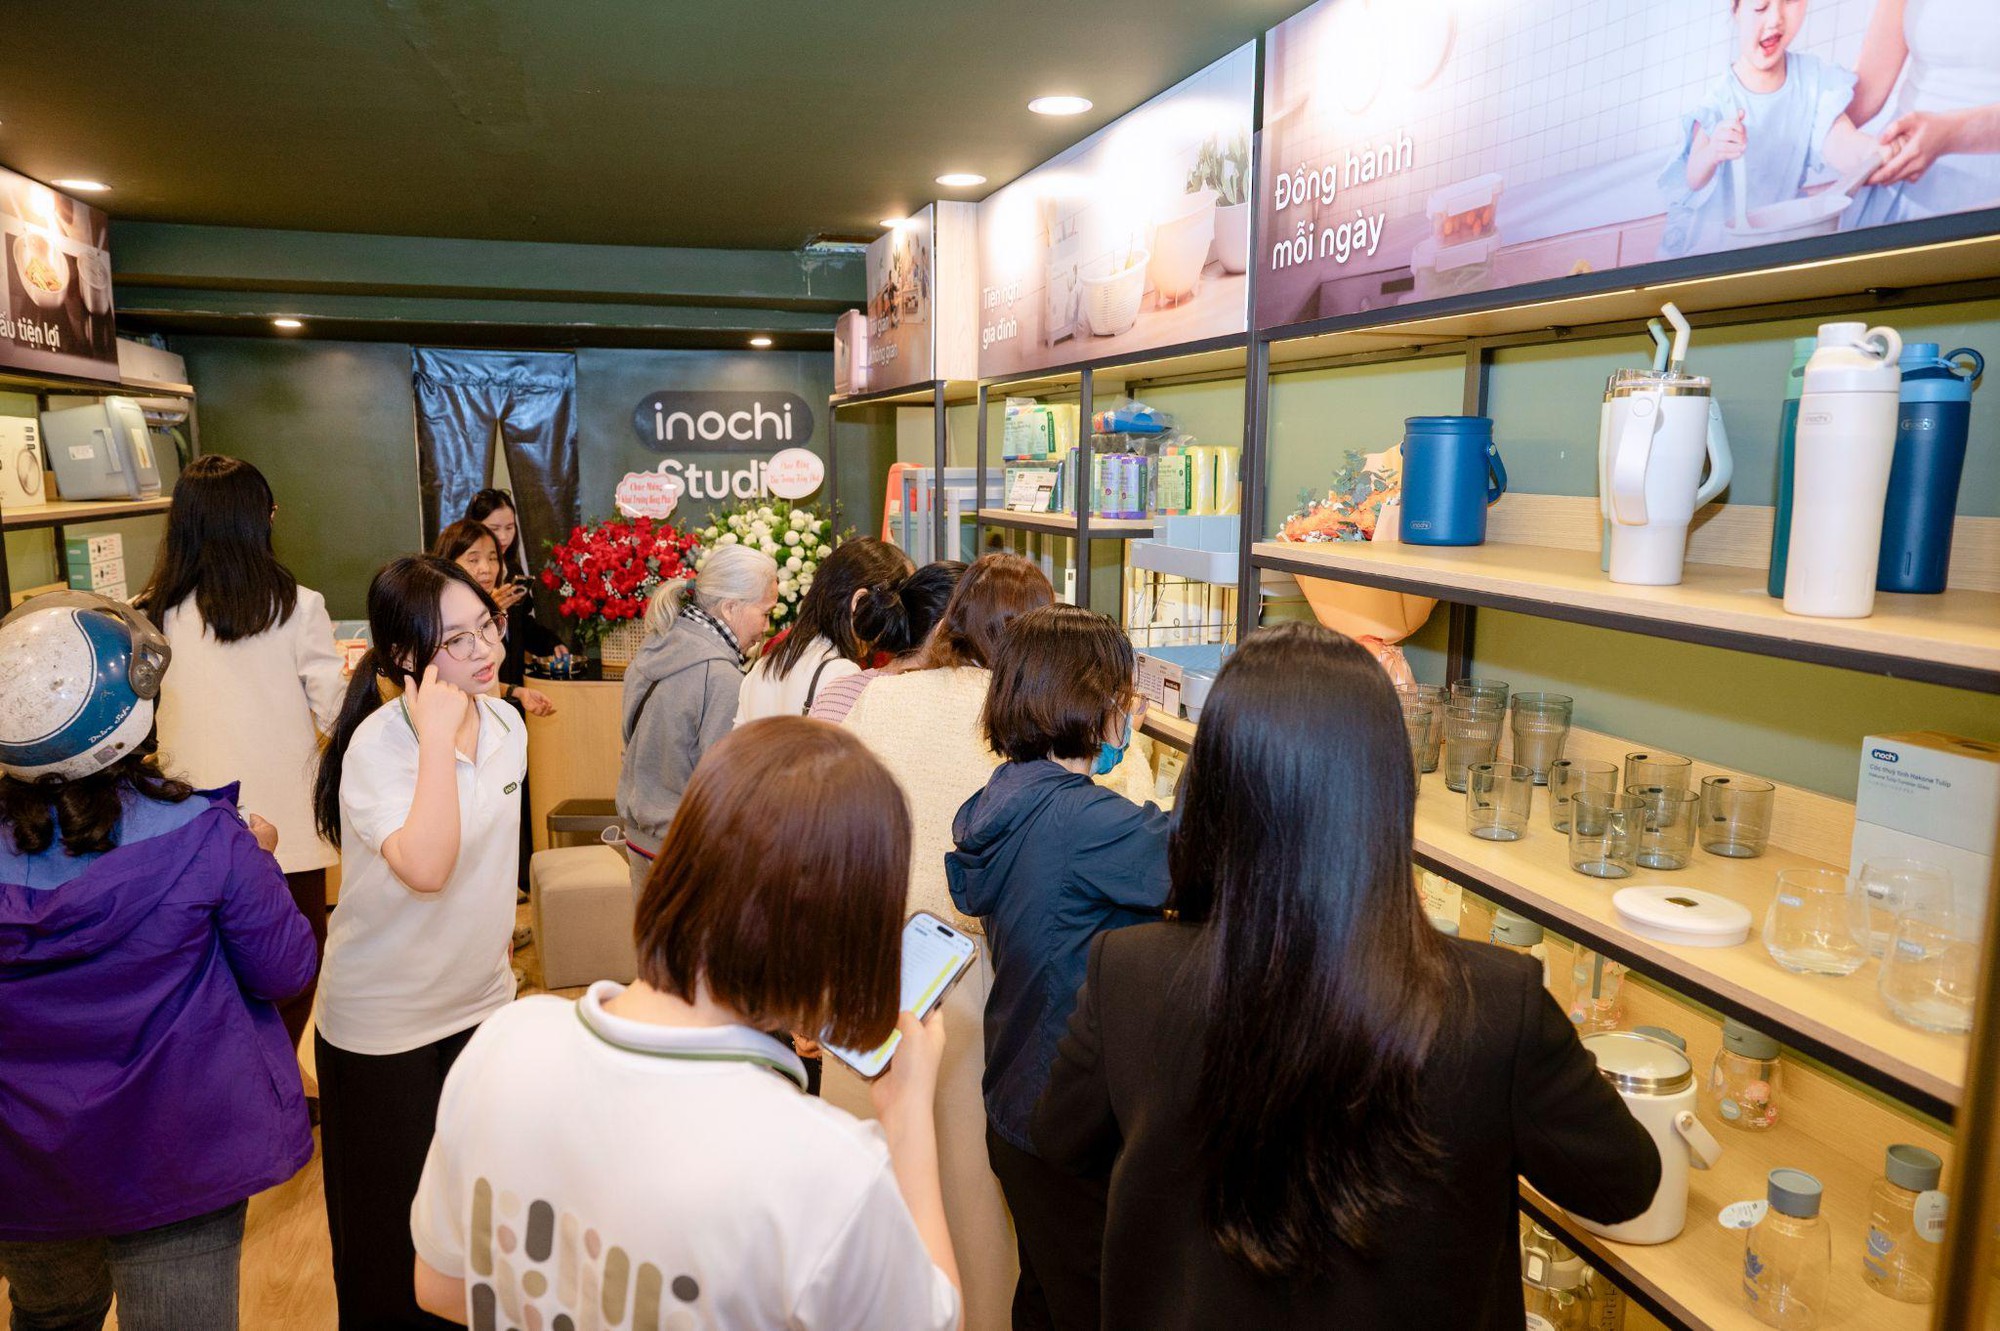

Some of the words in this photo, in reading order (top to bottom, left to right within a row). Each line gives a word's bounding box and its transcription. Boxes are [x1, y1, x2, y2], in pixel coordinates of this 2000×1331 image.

[1275, 162, 1337, 211] Đồng
[1344, 130, 1413, 188] hành
[1272, 220, 1315, 270] mỗi
[1320, 210, 1385, 264] ngày
[17, 317, 43, 348] tiện
[44, 322, 60, 352] lợi
[982, 321, 995, 350] gia
[997, 315, 1017, 341] đình
[654, 401, 792, 441] inochi
[657, 458, 768, 499] Studi
[1873, 749, 1897, 762] inochi
[1935, 778, 1951, 788] Tulip
